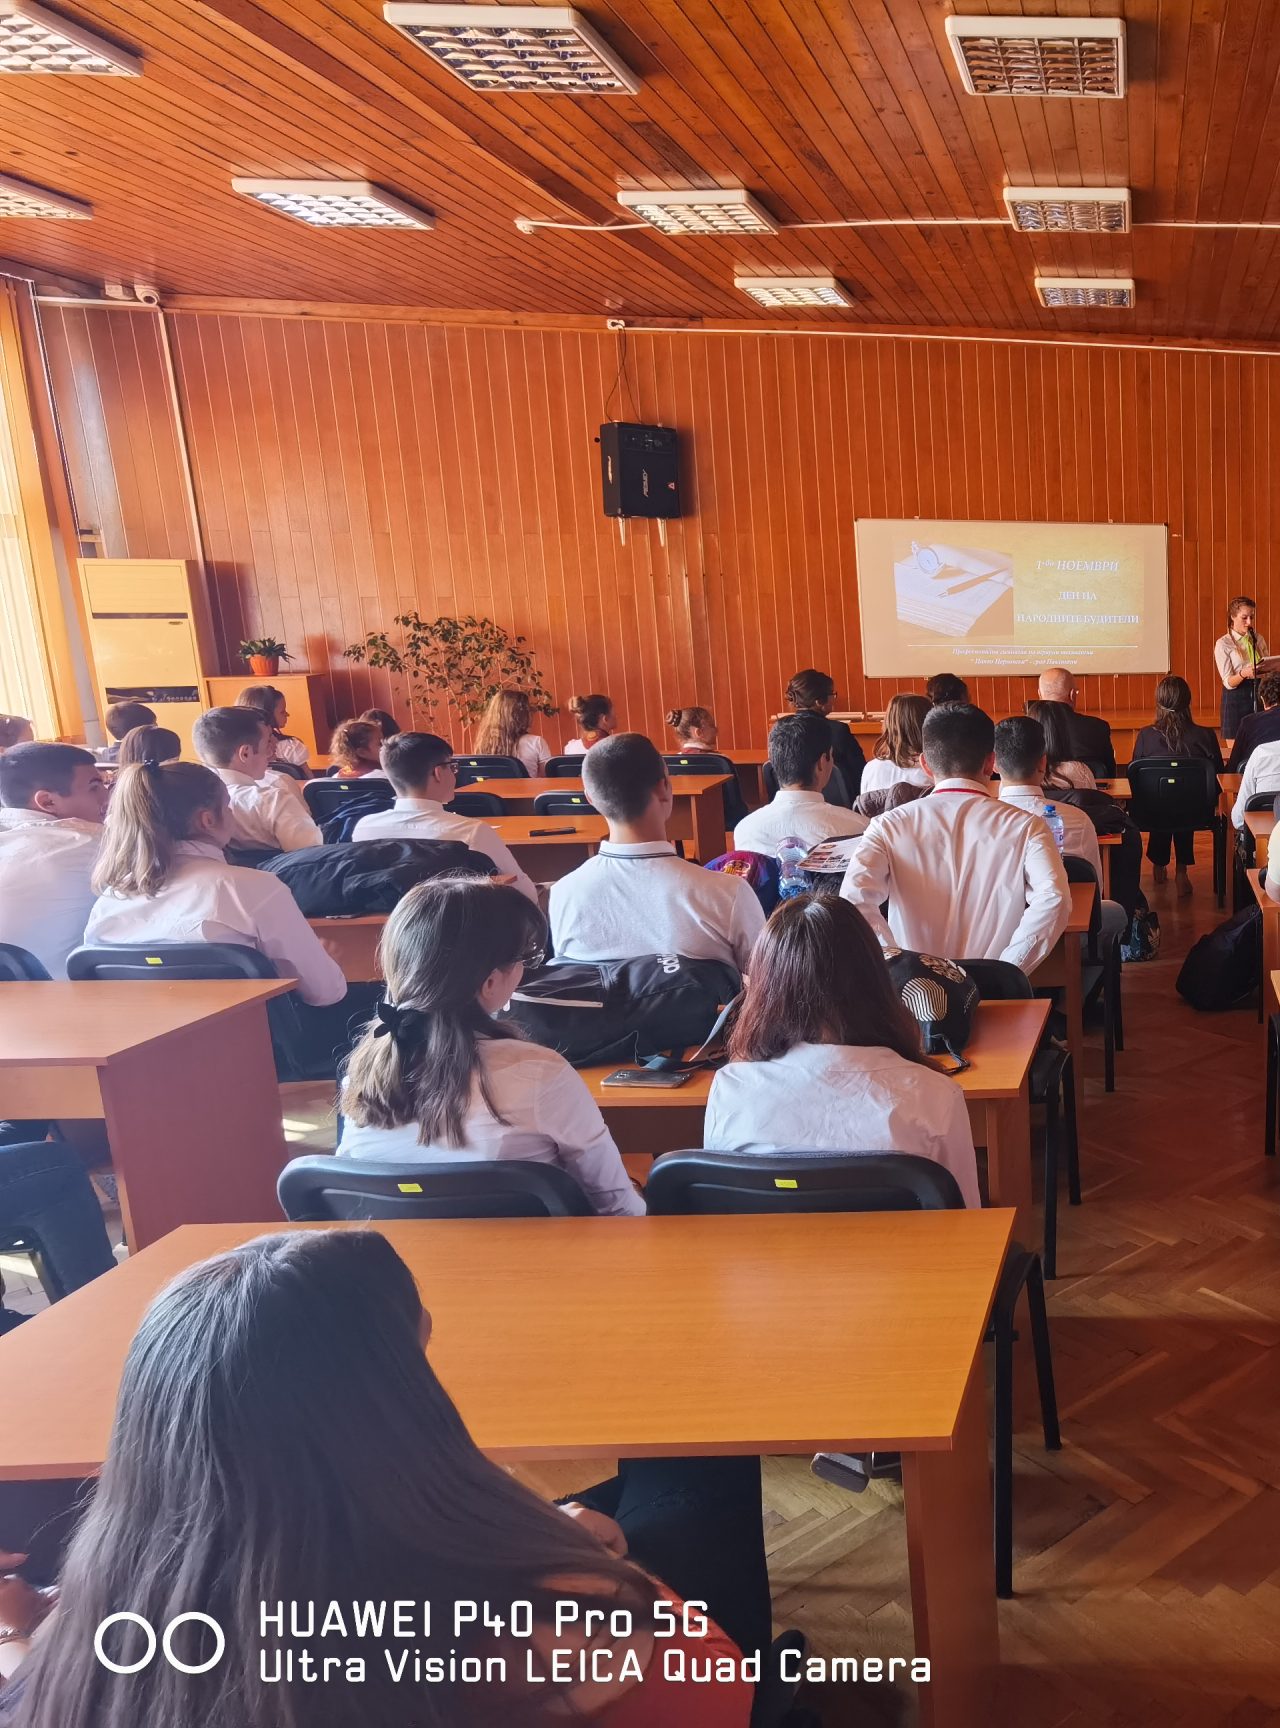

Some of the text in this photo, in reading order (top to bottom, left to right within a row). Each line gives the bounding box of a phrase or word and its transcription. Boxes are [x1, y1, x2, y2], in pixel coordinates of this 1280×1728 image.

[1057, 559, 1120, 572] НОЕМВРИ
[1016, 614, 1140, 624] НАРОДНИТЕ БУДИТЕЛИ
